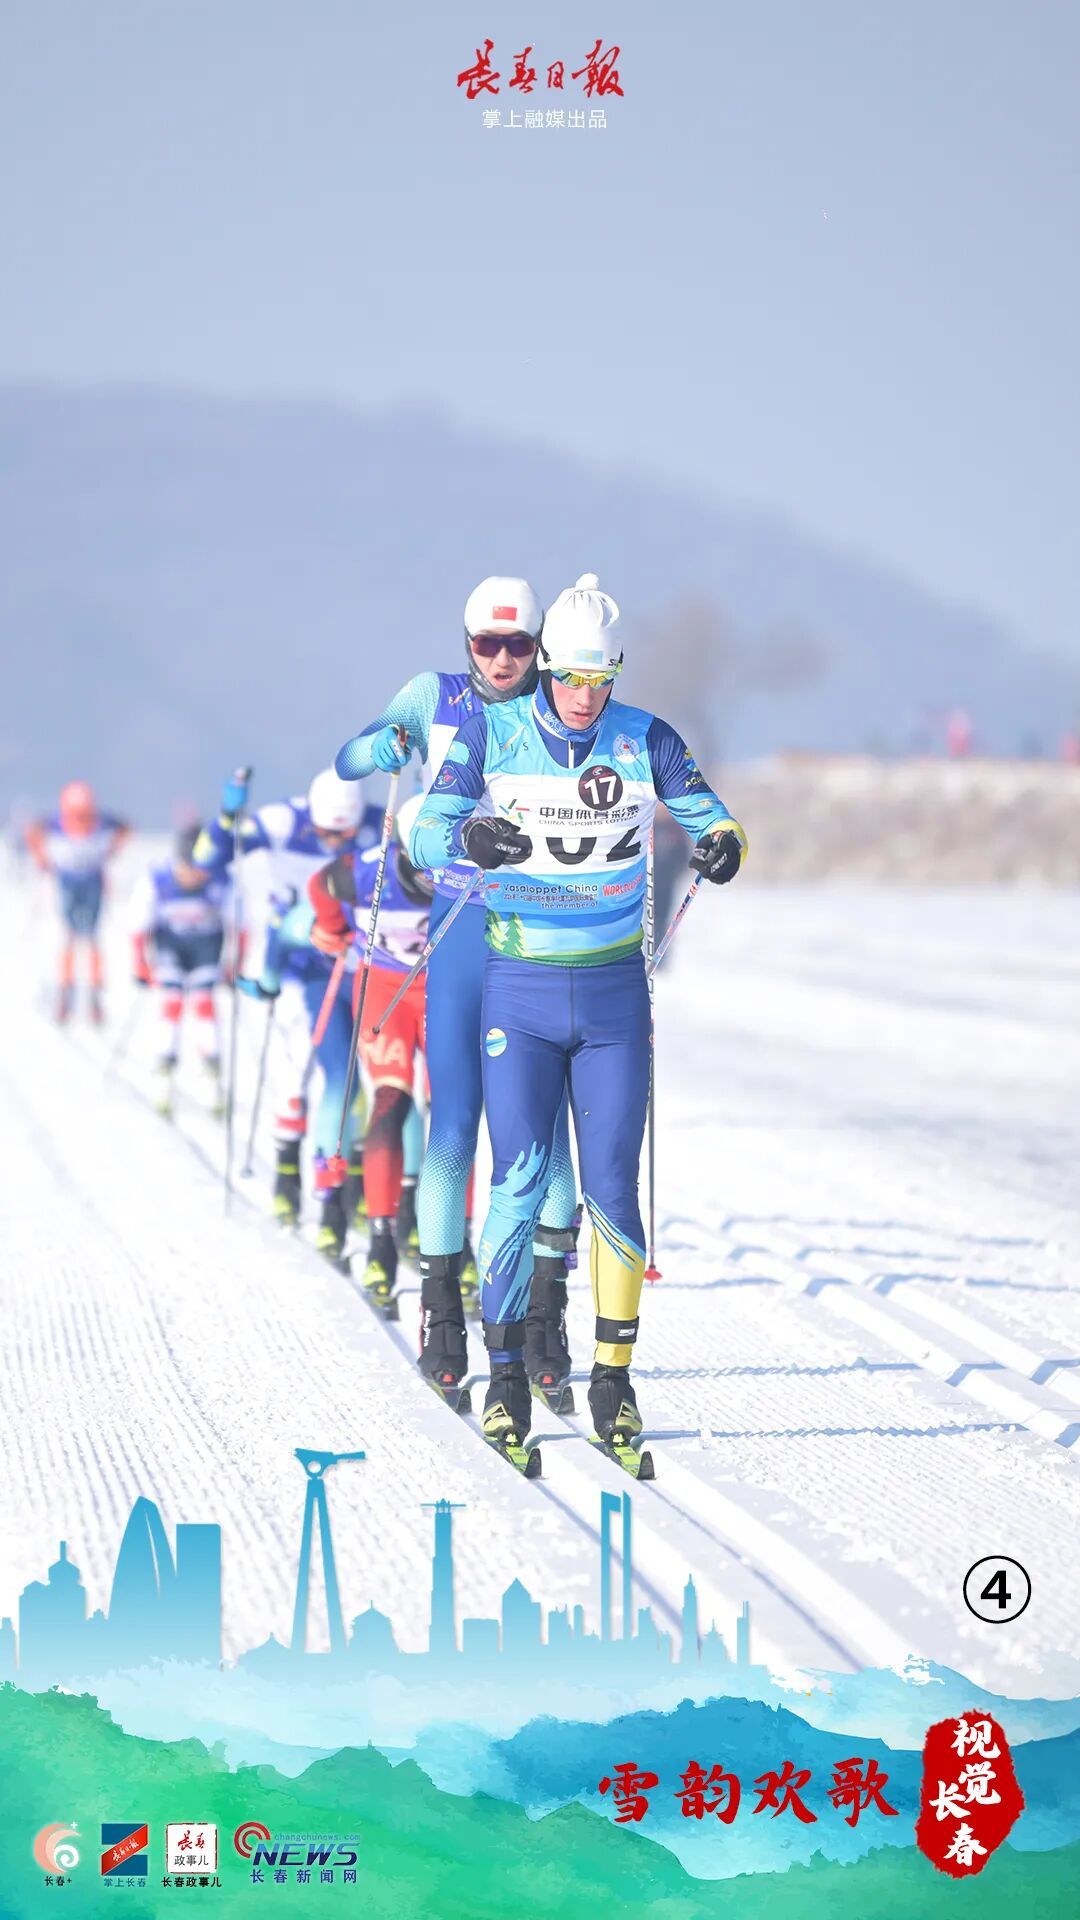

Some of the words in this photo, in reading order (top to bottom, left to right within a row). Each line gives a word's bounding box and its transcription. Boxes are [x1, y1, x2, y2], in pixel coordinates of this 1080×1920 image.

[584, 775, 617, 805] 17
[540, 804, 639, 820] 中国体育彩票
[504, 884, 561, 894] Vasaloppet
[565, 884, 598, 893] China
